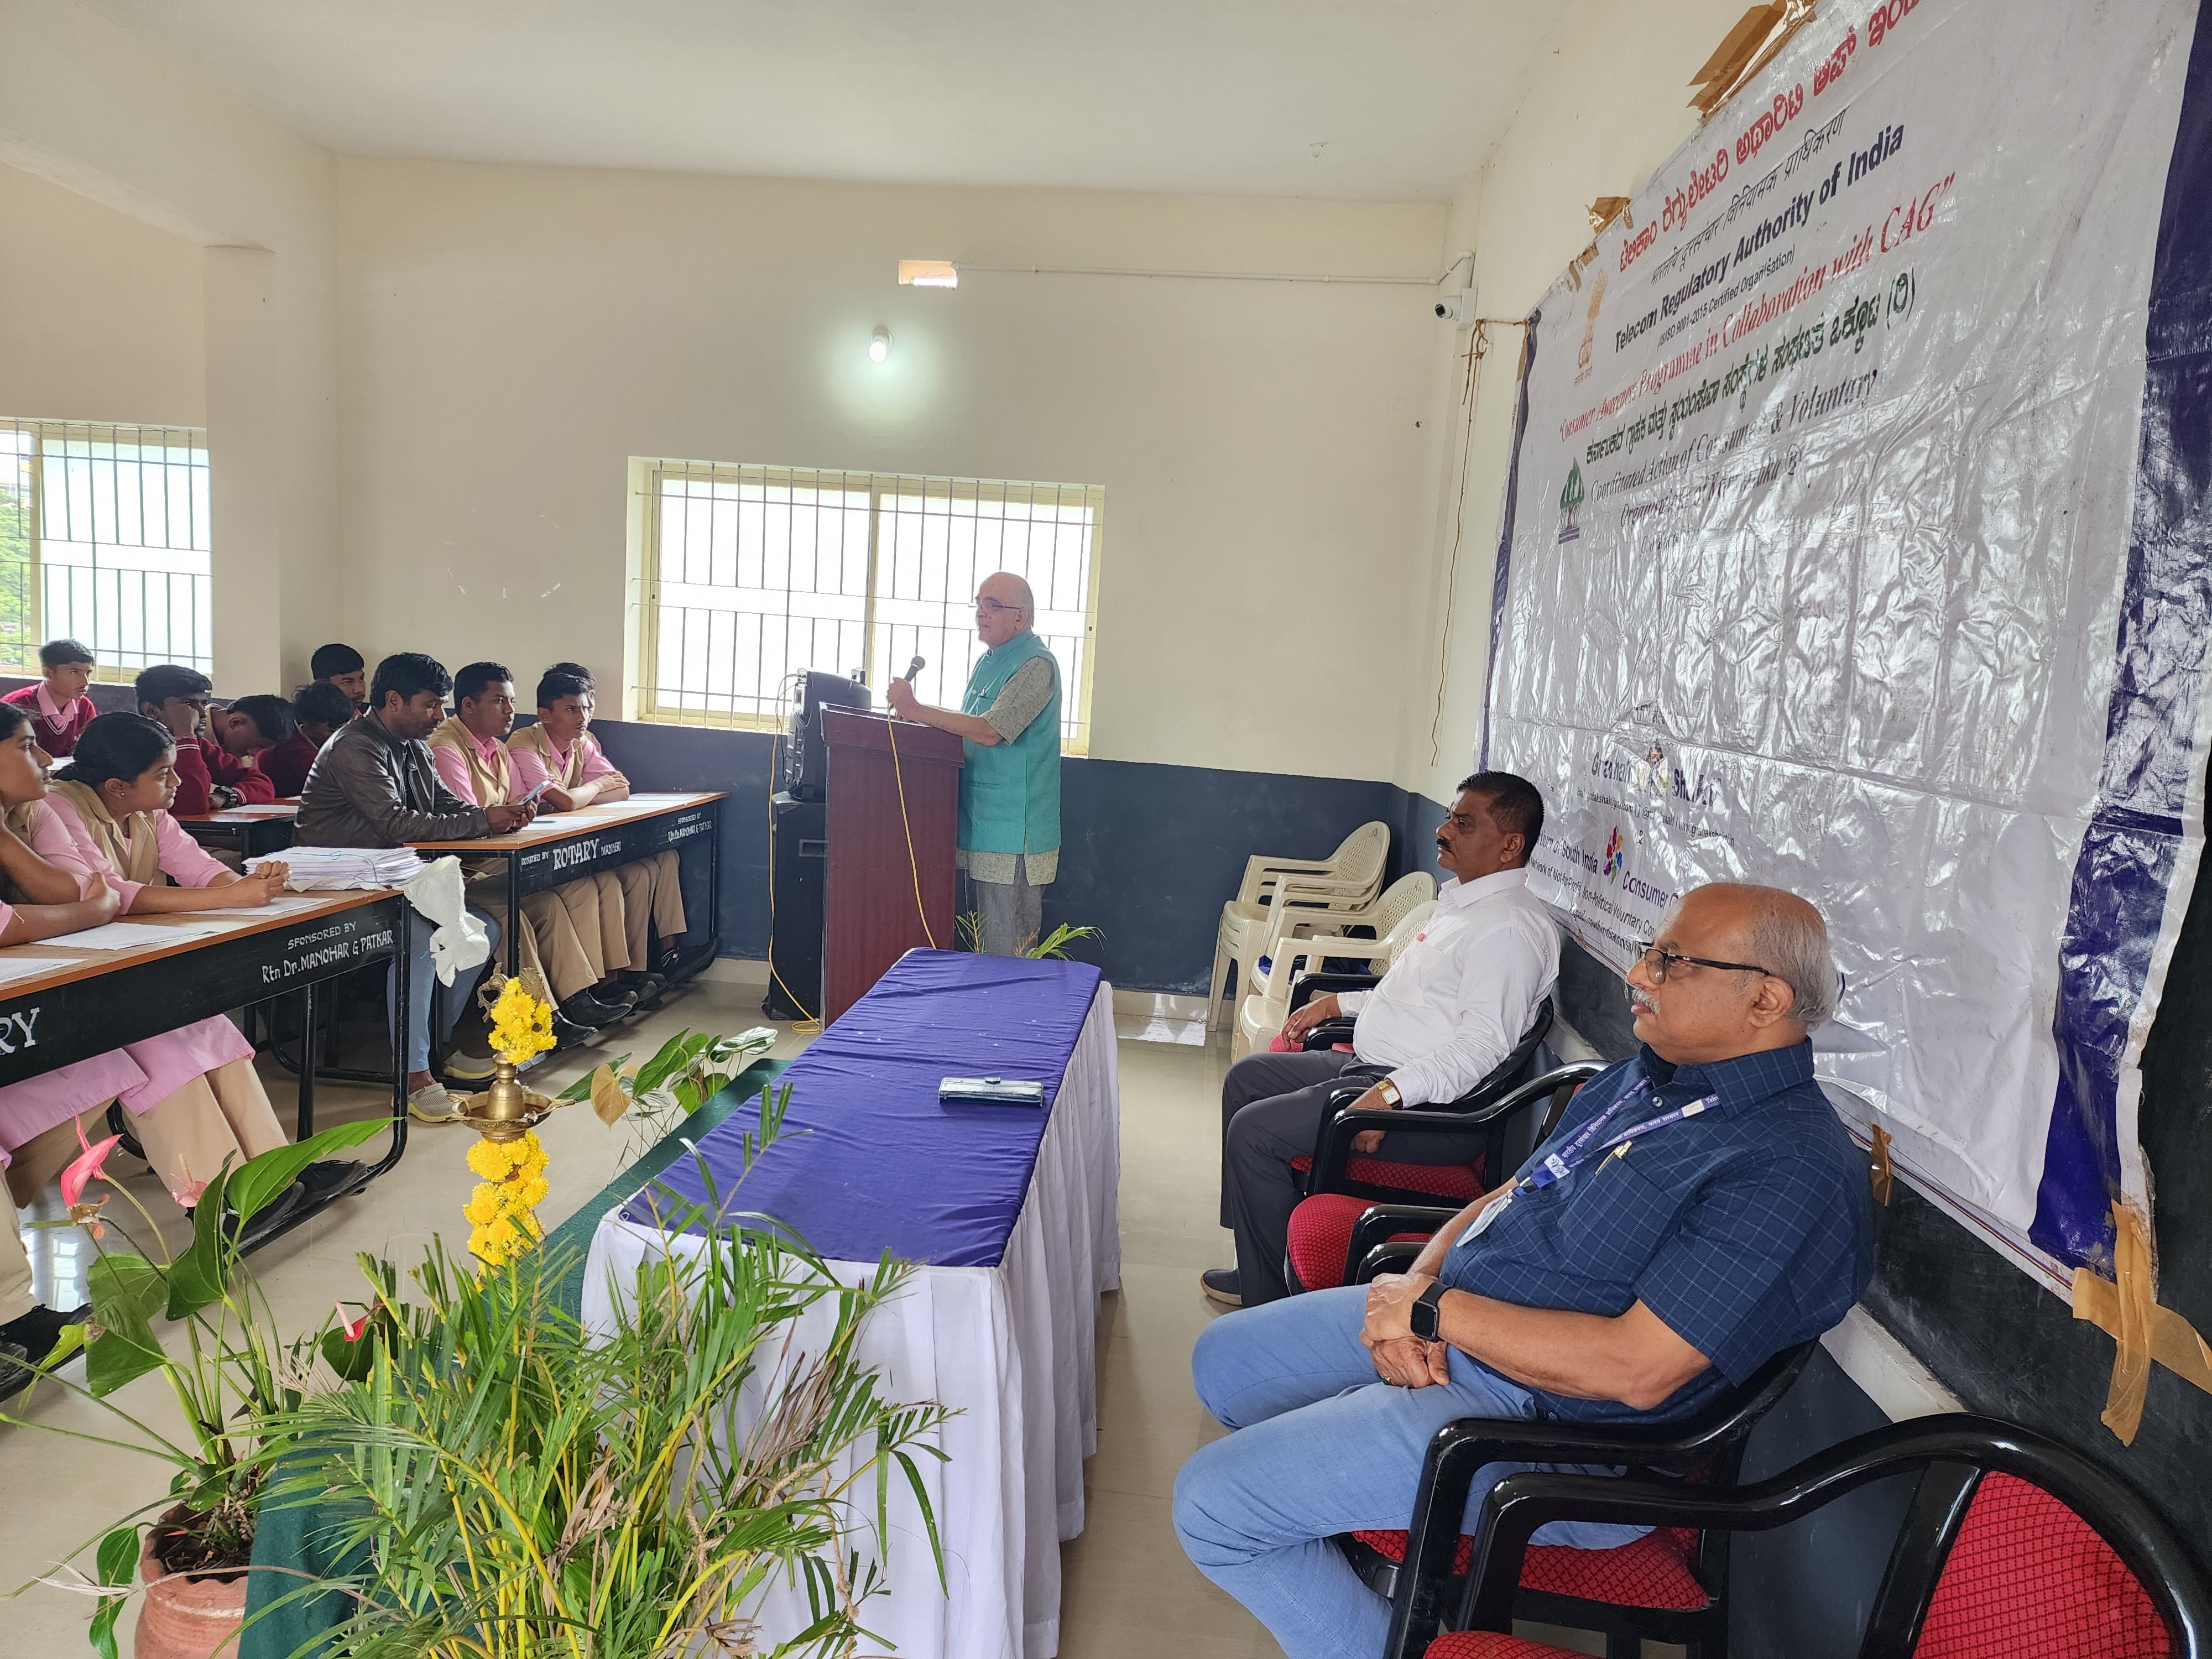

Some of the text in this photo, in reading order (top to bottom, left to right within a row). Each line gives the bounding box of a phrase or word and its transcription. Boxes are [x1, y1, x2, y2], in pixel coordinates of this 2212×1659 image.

[1783, 105, 1850, 181] प्राधिकरण
[1615, 124, 1905, 353] Telecom Regulatory Authority of India
[1620, 221, 1657, 273] ಟೆಲಿಕಾಂ
[1676, 307, 1707, 335] 9001-2015
[1709, 280, 1740, 311] Certified
[1704, 327, 1718, 359] in
[1723, 264, 1826, 348] Collaboration
[1830, 225, 1874, 284] with
[1591, 460, 1647, 505] Coordinated
[1645, 451, 1679, 483] Action
[1679, 437, 1697, 474] of
[542, 851, 550, 860] BY
[552, 838, 599, 870] ROTARY
[1562, 841, 1580, 865] South
[1582, 849, 1598, 874] India
[1623, 870, 1669, 910] Consumer
[1530, 856, 1547, 875] Network
[1547, 867, 1553, 878] of
[1613, 904, 1642, 933] Voluntary
[262, 965, 281, 984] Rtn
[352, 941, 359, 956] G
[360, 930, 394, 952] PATKAR
[287, 921, 357, 951] SPONSORED BY
